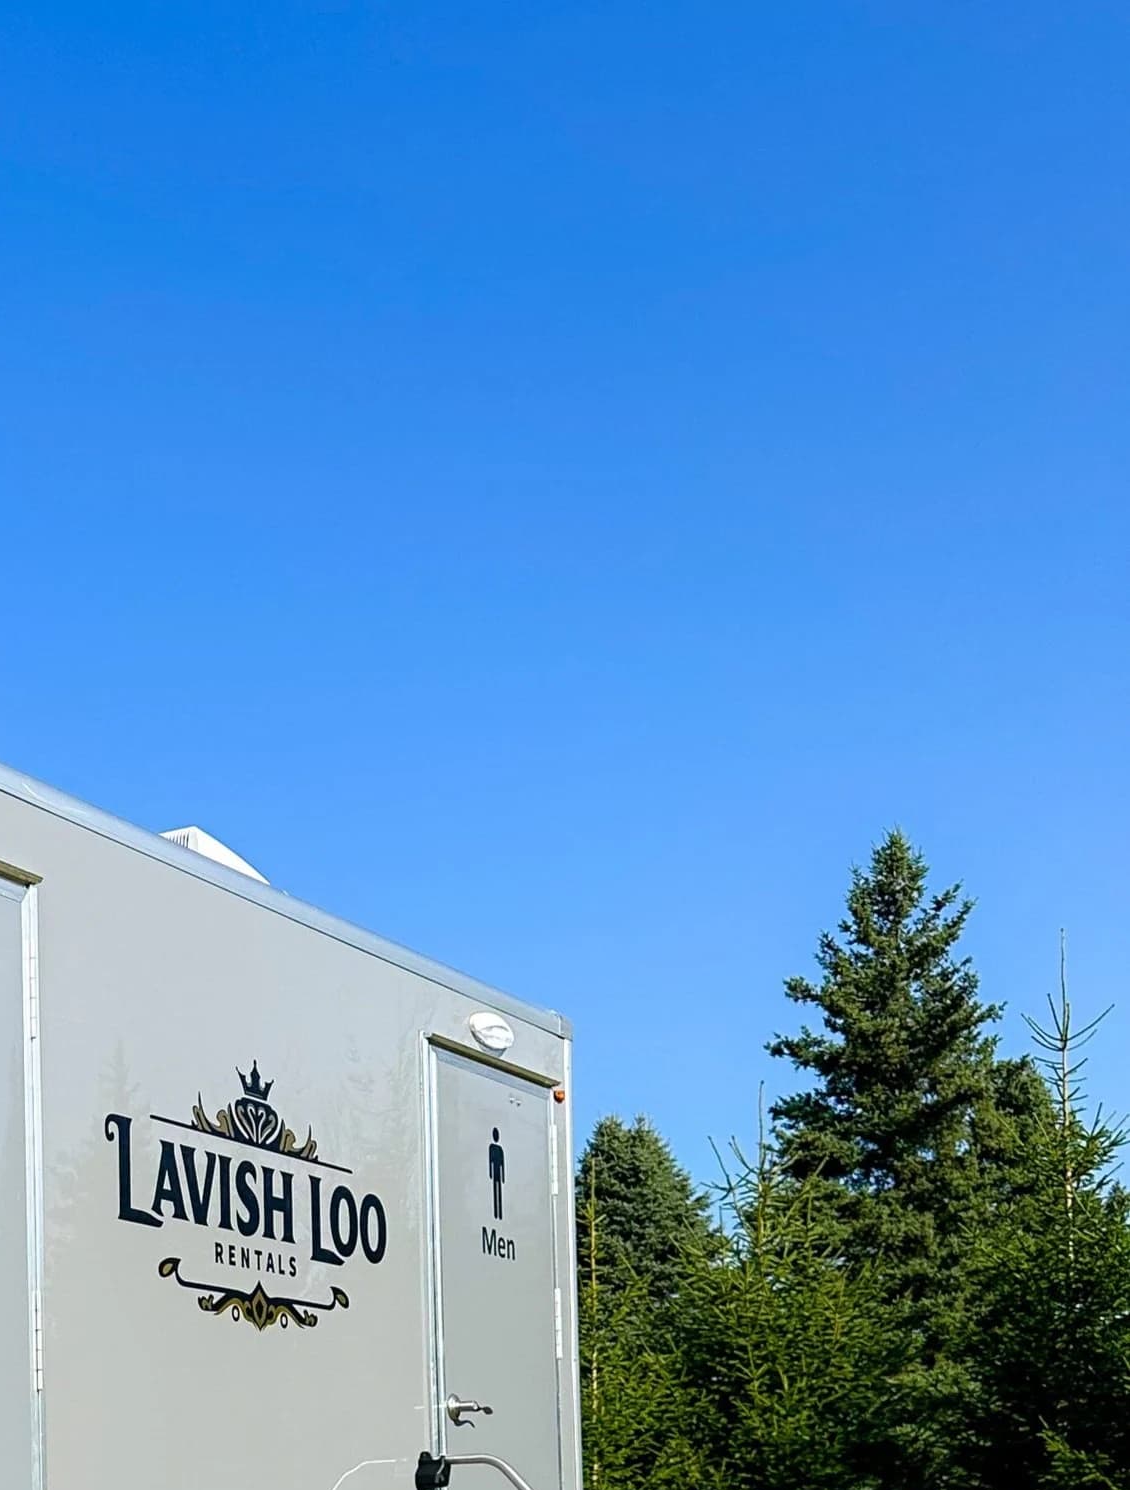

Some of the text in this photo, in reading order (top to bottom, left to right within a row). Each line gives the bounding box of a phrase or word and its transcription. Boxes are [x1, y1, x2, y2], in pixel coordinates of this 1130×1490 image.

[104, 1113, 388, 1266] LAVISH LOO
[214, 1242, 298, 1277] RENTALS
[481, 1226, 516, 1261] Men
